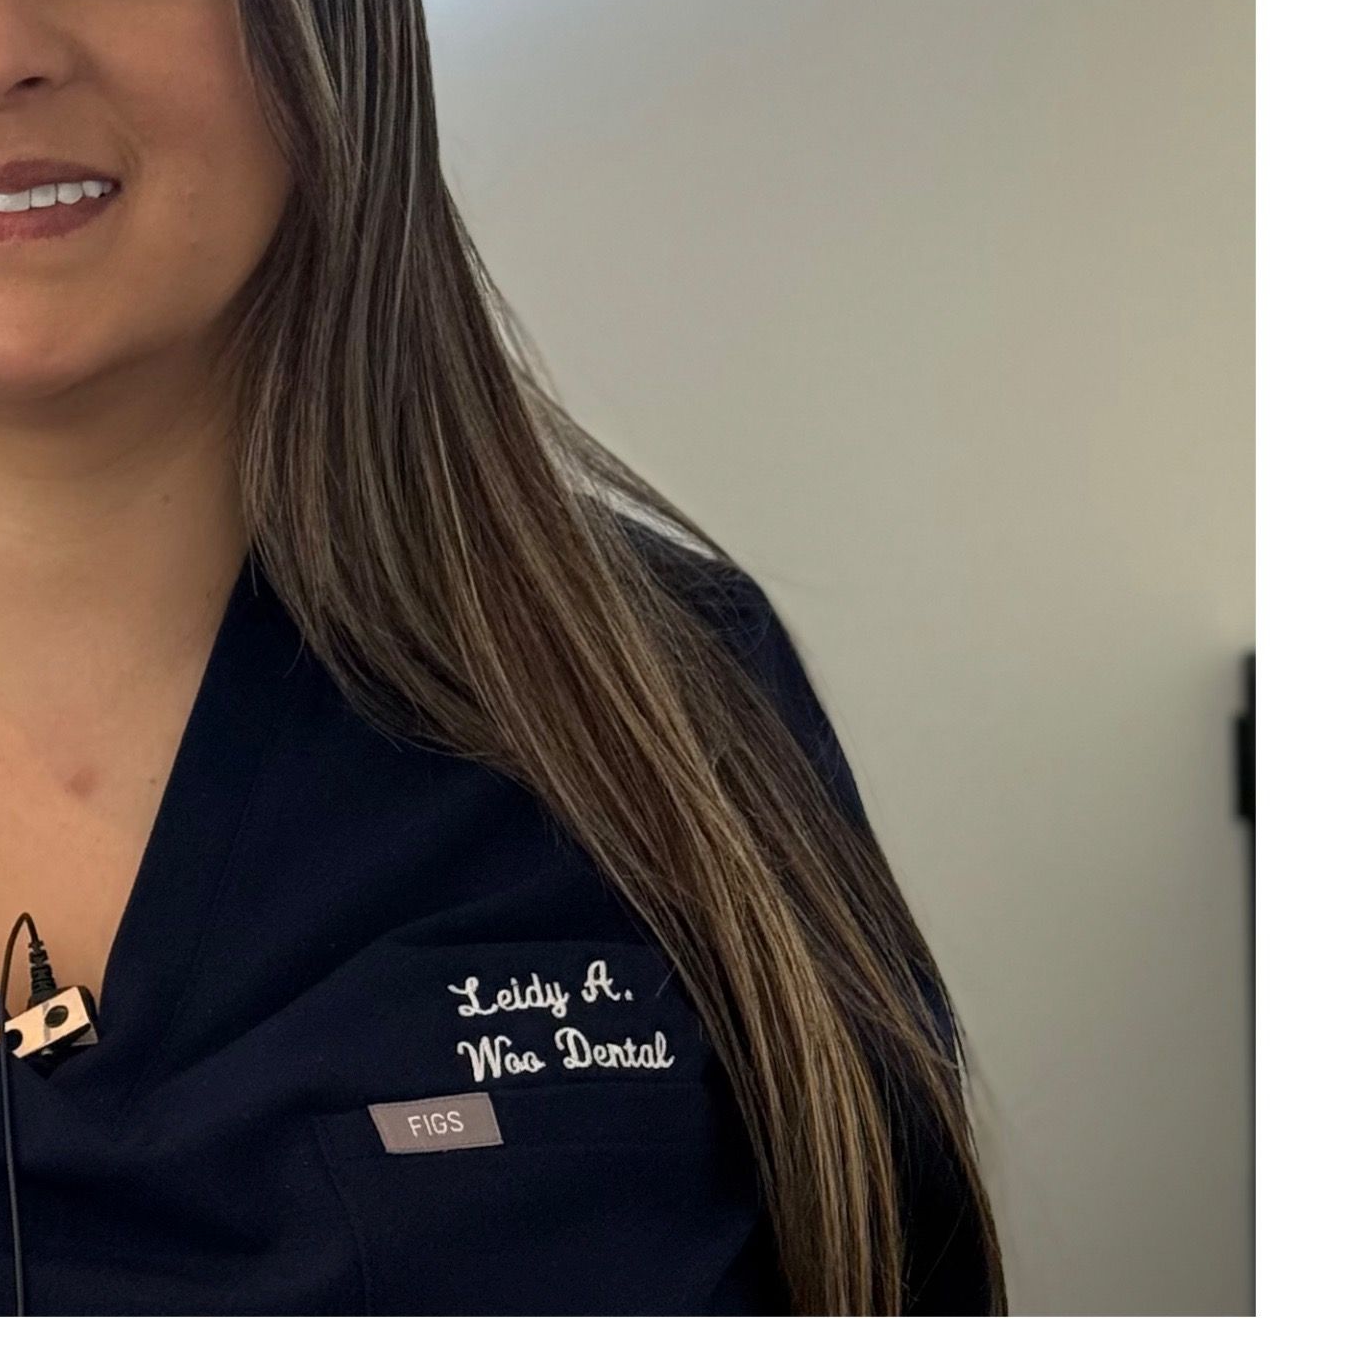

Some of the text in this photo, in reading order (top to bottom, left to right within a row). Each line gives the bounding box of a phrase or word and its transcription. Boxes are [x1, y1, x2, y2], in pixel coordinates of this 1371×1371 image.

[447, 959, 634, 1019] Leidy A.
[456, 1026, 676, 1083] Woo Dental
[407, 1110, 465, 1138] FIGS
